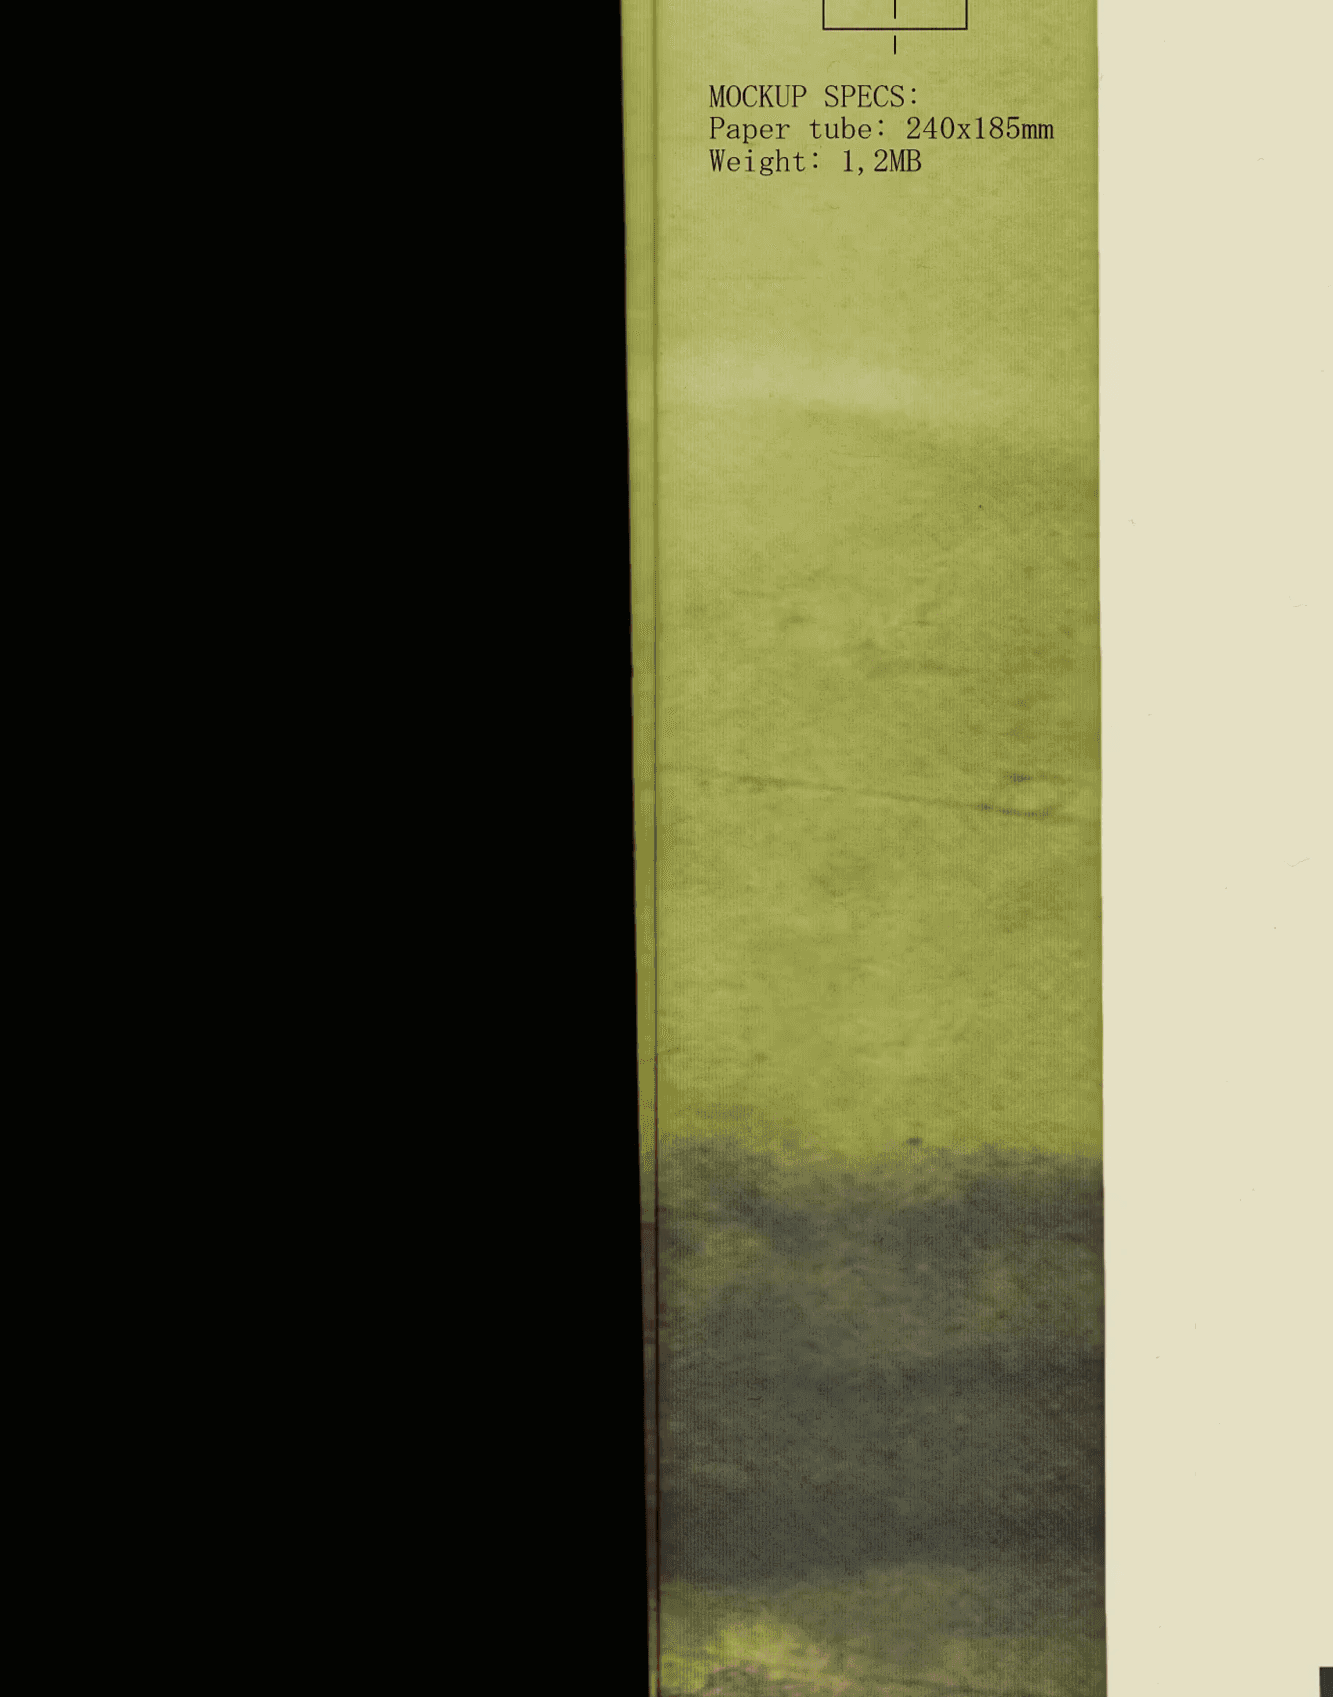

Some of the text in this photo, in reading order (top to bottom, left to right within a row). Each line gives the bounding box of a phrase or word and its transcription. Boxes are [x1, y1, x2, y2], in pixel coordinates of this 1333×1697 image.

[708, 84, 917, 108] MOCKUP SPECS:
[709, 115, 1055, 145] Paper tube: 240x185mm
[708, 148, 922, 177] Weight: 1,2MB
